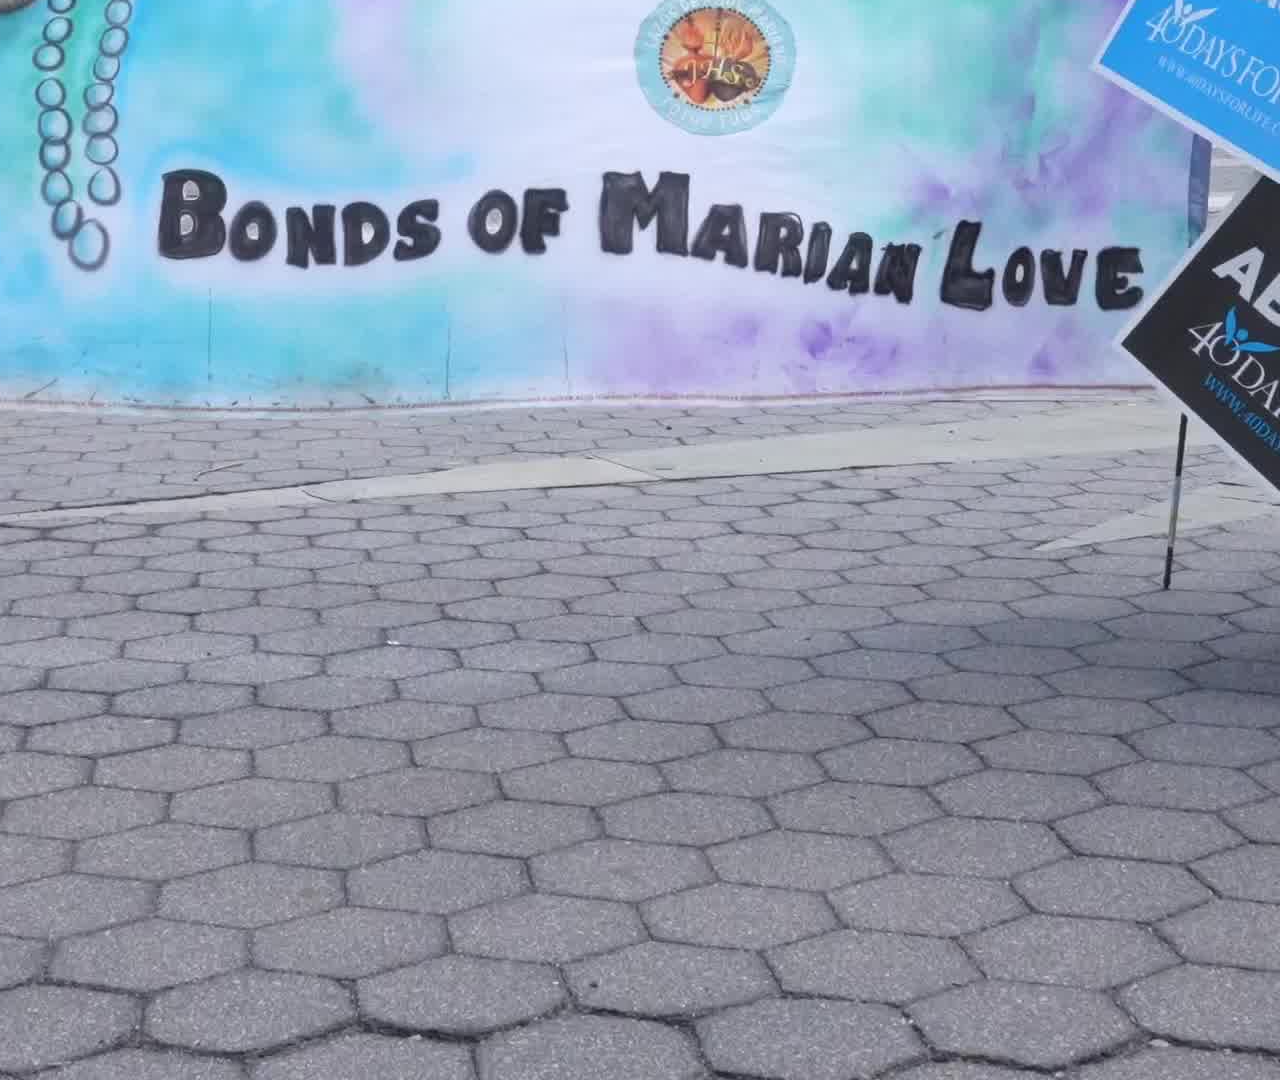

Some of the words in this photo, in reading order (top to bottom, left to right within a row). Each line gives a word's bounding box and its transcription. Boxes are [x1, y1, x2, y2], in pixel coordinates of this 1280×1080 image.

[1178, 23, 1247, 79] DAYS
[157, 168, 441, 269] BONDS
[467, 187, 569, 255] OF
[600, 171, 921, 304] MARIAN
[940, 220, 1145, 312] LOVE
[1186, 319, 1241, 368] 40
